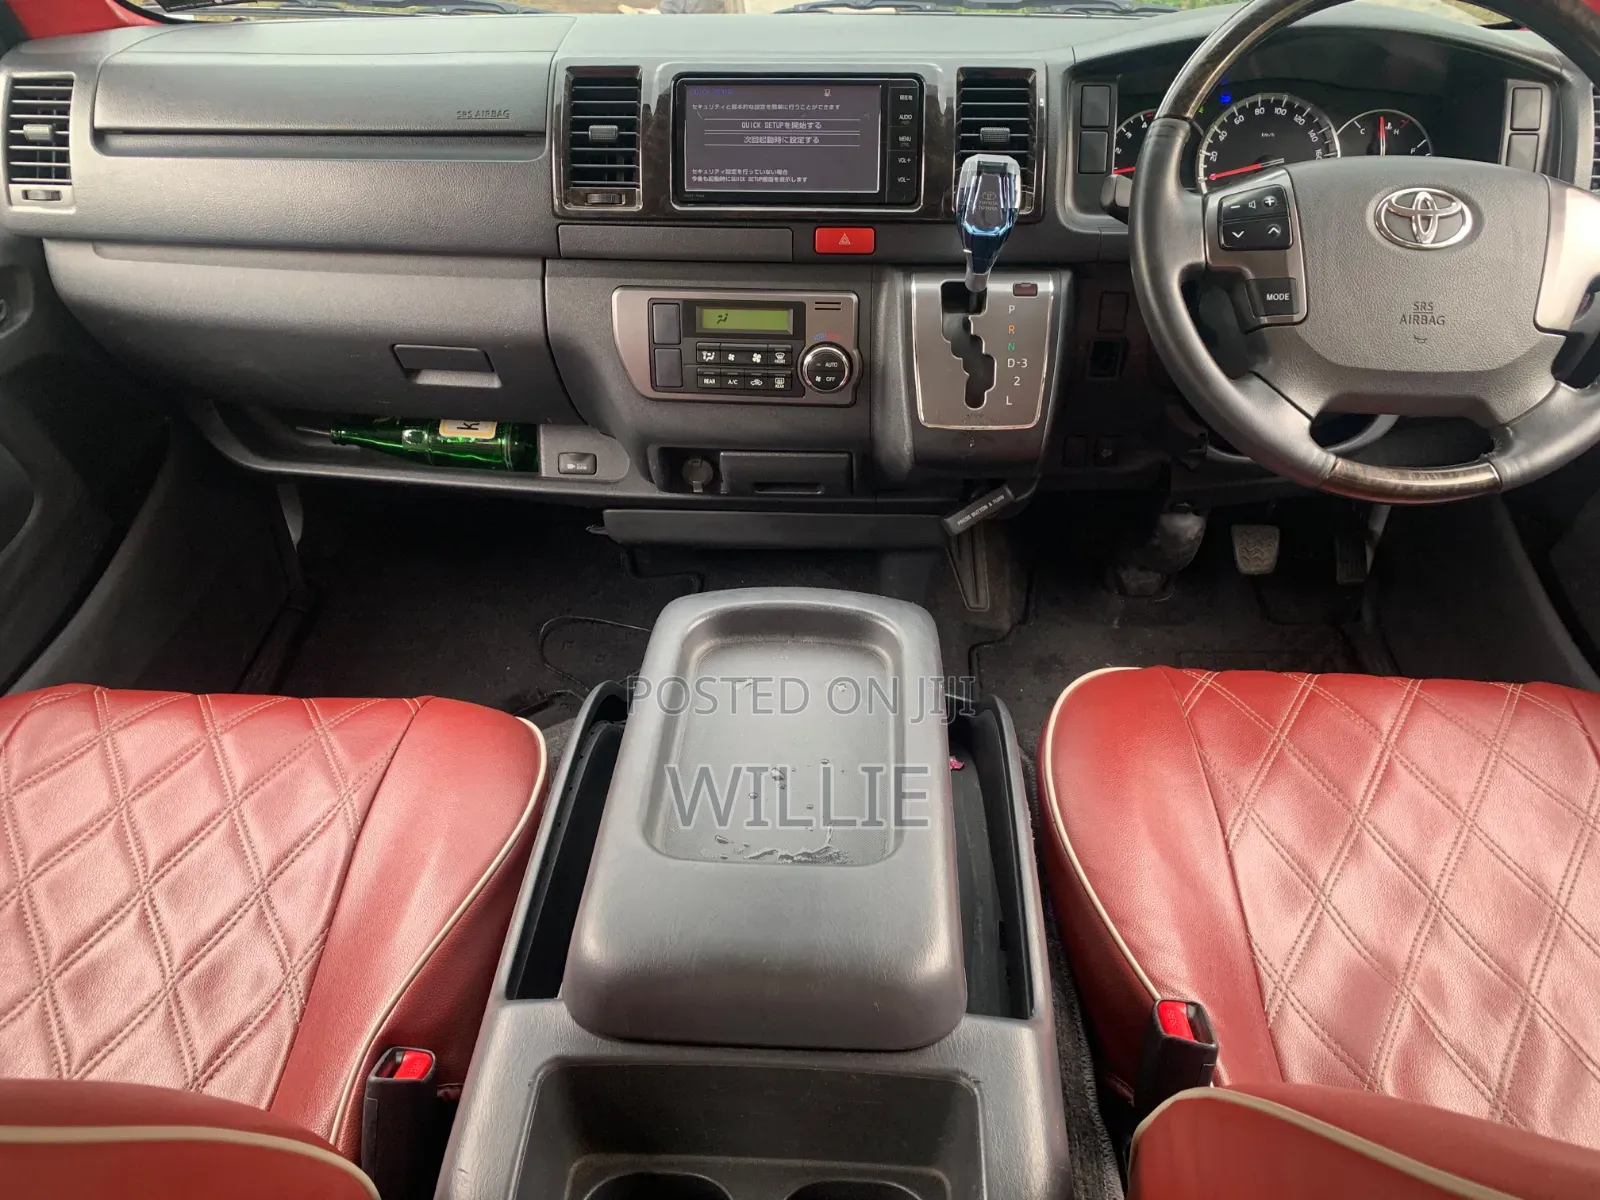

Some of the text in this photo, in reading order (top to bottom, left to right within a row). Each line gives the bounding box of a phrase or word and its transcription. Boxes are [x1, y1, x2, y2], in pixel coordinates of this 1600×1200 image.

[457, 109, 510, 119] SRS AIRBAG
[1254, 107, 1266, 116] 80
[1274, 107, 1288, 116] 100
[1233, 115, 1245, 125] 60
[1293, 114, 1306, 126] 120
[1141, 121, 1148, 129] 4
[743, 135, 820, 144] 次回起動時に設定する
[1125, 131, 1133, 139] 3
[1218, 130, 1229, 142] 40
[1306, 129, 1319, 143] 140
[1209, 151, 1219, 162] 20
[1266, 292, 1290, 301] MODE
[1009, 305, 1016, 314] P
[1413, 301, 1434, 312] SRS
[1400, 313, 1446, 326] AIRBAG
[1009, 325, 1015, 334] R
[1008, 342, 1016, 351] N
[1007, 358, 1028, 368] D-3
[1013, 376, 1021, 386] 2
[1006, 396, 1013, 405] L
